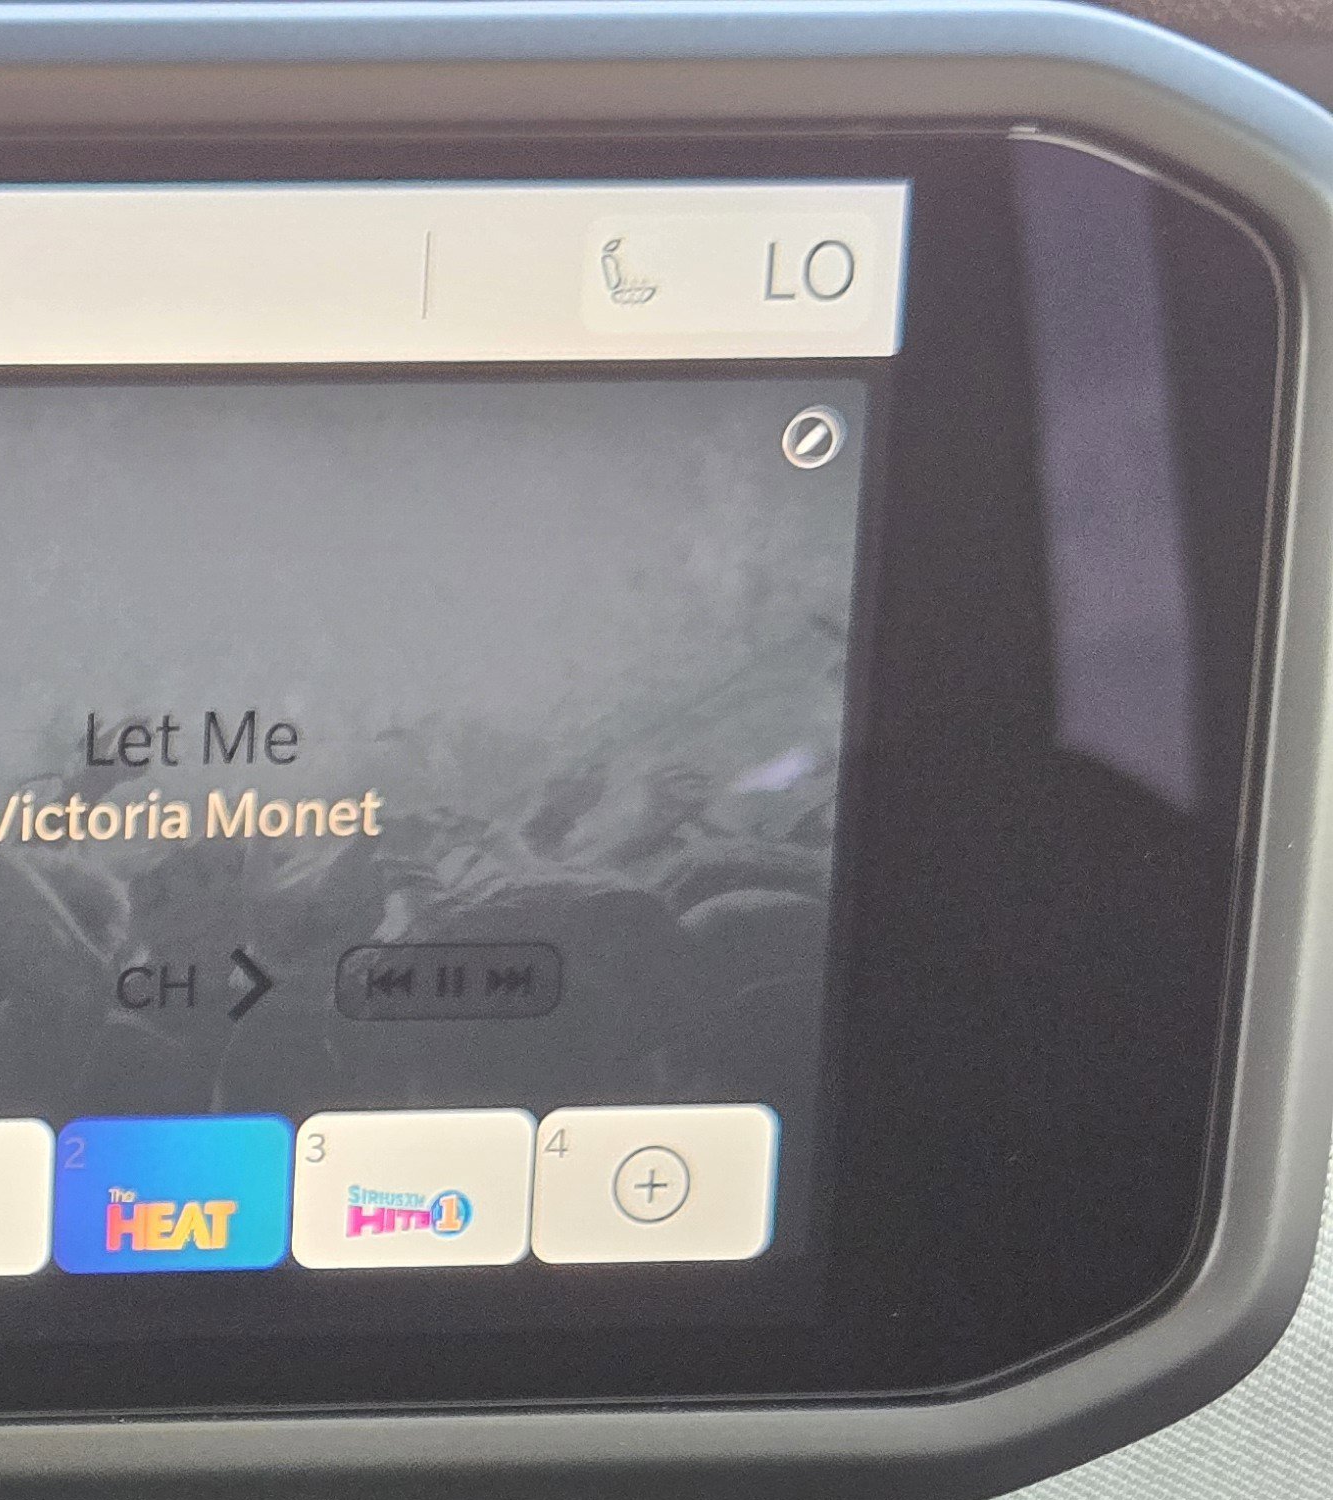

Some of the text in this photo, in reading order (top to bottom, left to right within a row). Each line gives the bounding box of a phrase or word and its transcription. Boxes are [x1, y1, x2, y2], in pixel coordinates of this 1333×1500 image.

[764, 238, 857, 302] LO
[85, 710, 299, 768] Let Me
[205, 788, 384, 839] Monet
[116, 964, 197, 1009] CH
[63, 1137, 87, 1170] 2
[305, 1133, 328, 1163] 3
[543, 1128, 569, 1159] 4
[106, 1200, 237, 1252] HEAT
[436, 1194, 462, 1232] 1
